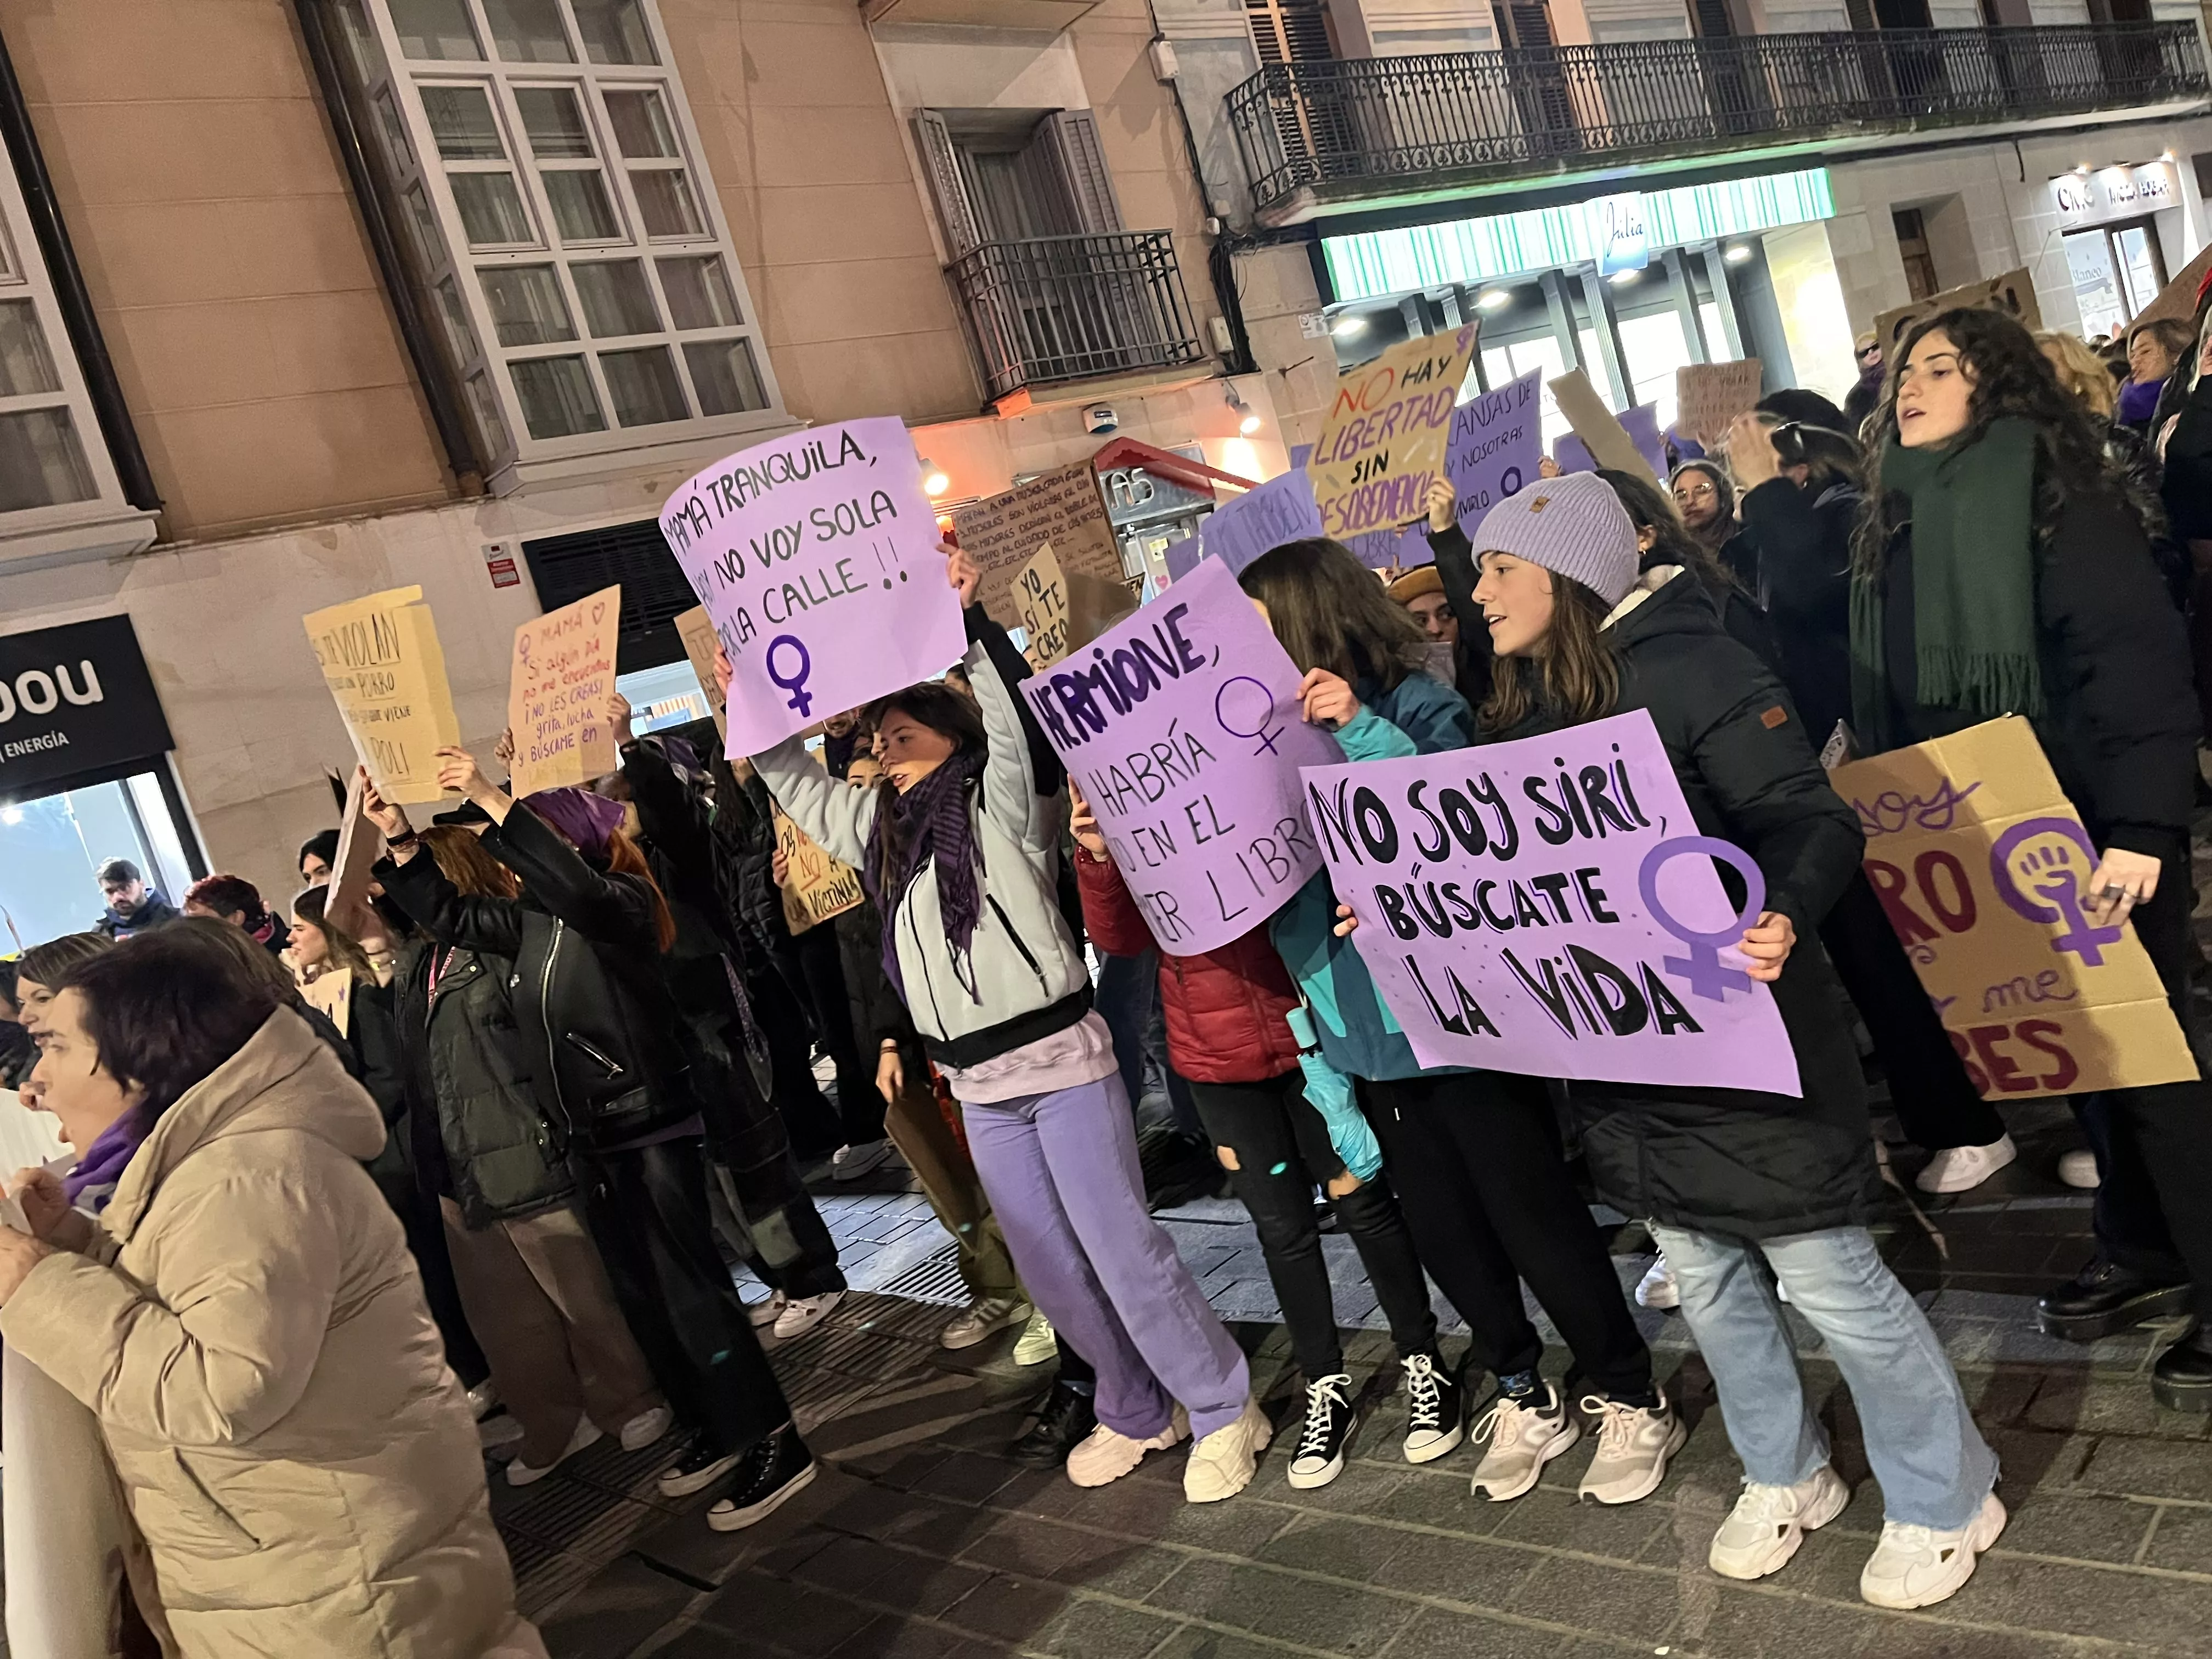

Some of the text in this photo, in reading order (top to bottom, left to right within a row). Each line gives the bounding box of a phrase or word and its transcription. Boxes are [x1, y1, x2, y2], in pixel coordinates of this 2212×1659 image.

[1333, 356, 1452, 420] NO HAY
[1519, 380, 1533, 408] DE
[1315, 386, 1455, 465] LIBERTAD
[1351, 449, 1389, 484] SIN
[1462, 425, 1523, 473] NOSOTRAS
[663, 479, 713, 556] MAMÁ
[1052, 524, 1066, 537] DE
[714, 549, 746, 590] NO
[750, 521, 802, 568] VOY
[810, 490, 897, 541] SOLA
[1020, 568, 1041, 602] YO
[1039, 580, 1065, 618] TE
[730, 607, 757, 644] LA
[1037, 618, 1068, 660] CREO
[550, 691, 567, 712] LES
[567, 706, 595, 727] lucha
[4, 730, 70, 758] ENERGÍA
[582, 727, 597, 743] en
[1088, 718, 1216, 817] HABRÍA
[1132, 820, 1177, 867] EN
[1184, 794, 1236, 845] EL
[1309, 777, 1398, 865] NO
[1407, 771, 1519, 862] SOY
[799, 851, 822, 879] NO
[1374, 862, 1620, 941] BÚSCATE
[1401, 953, 1503, 1037] LA
[1983, 969, 2078, 1013] me
